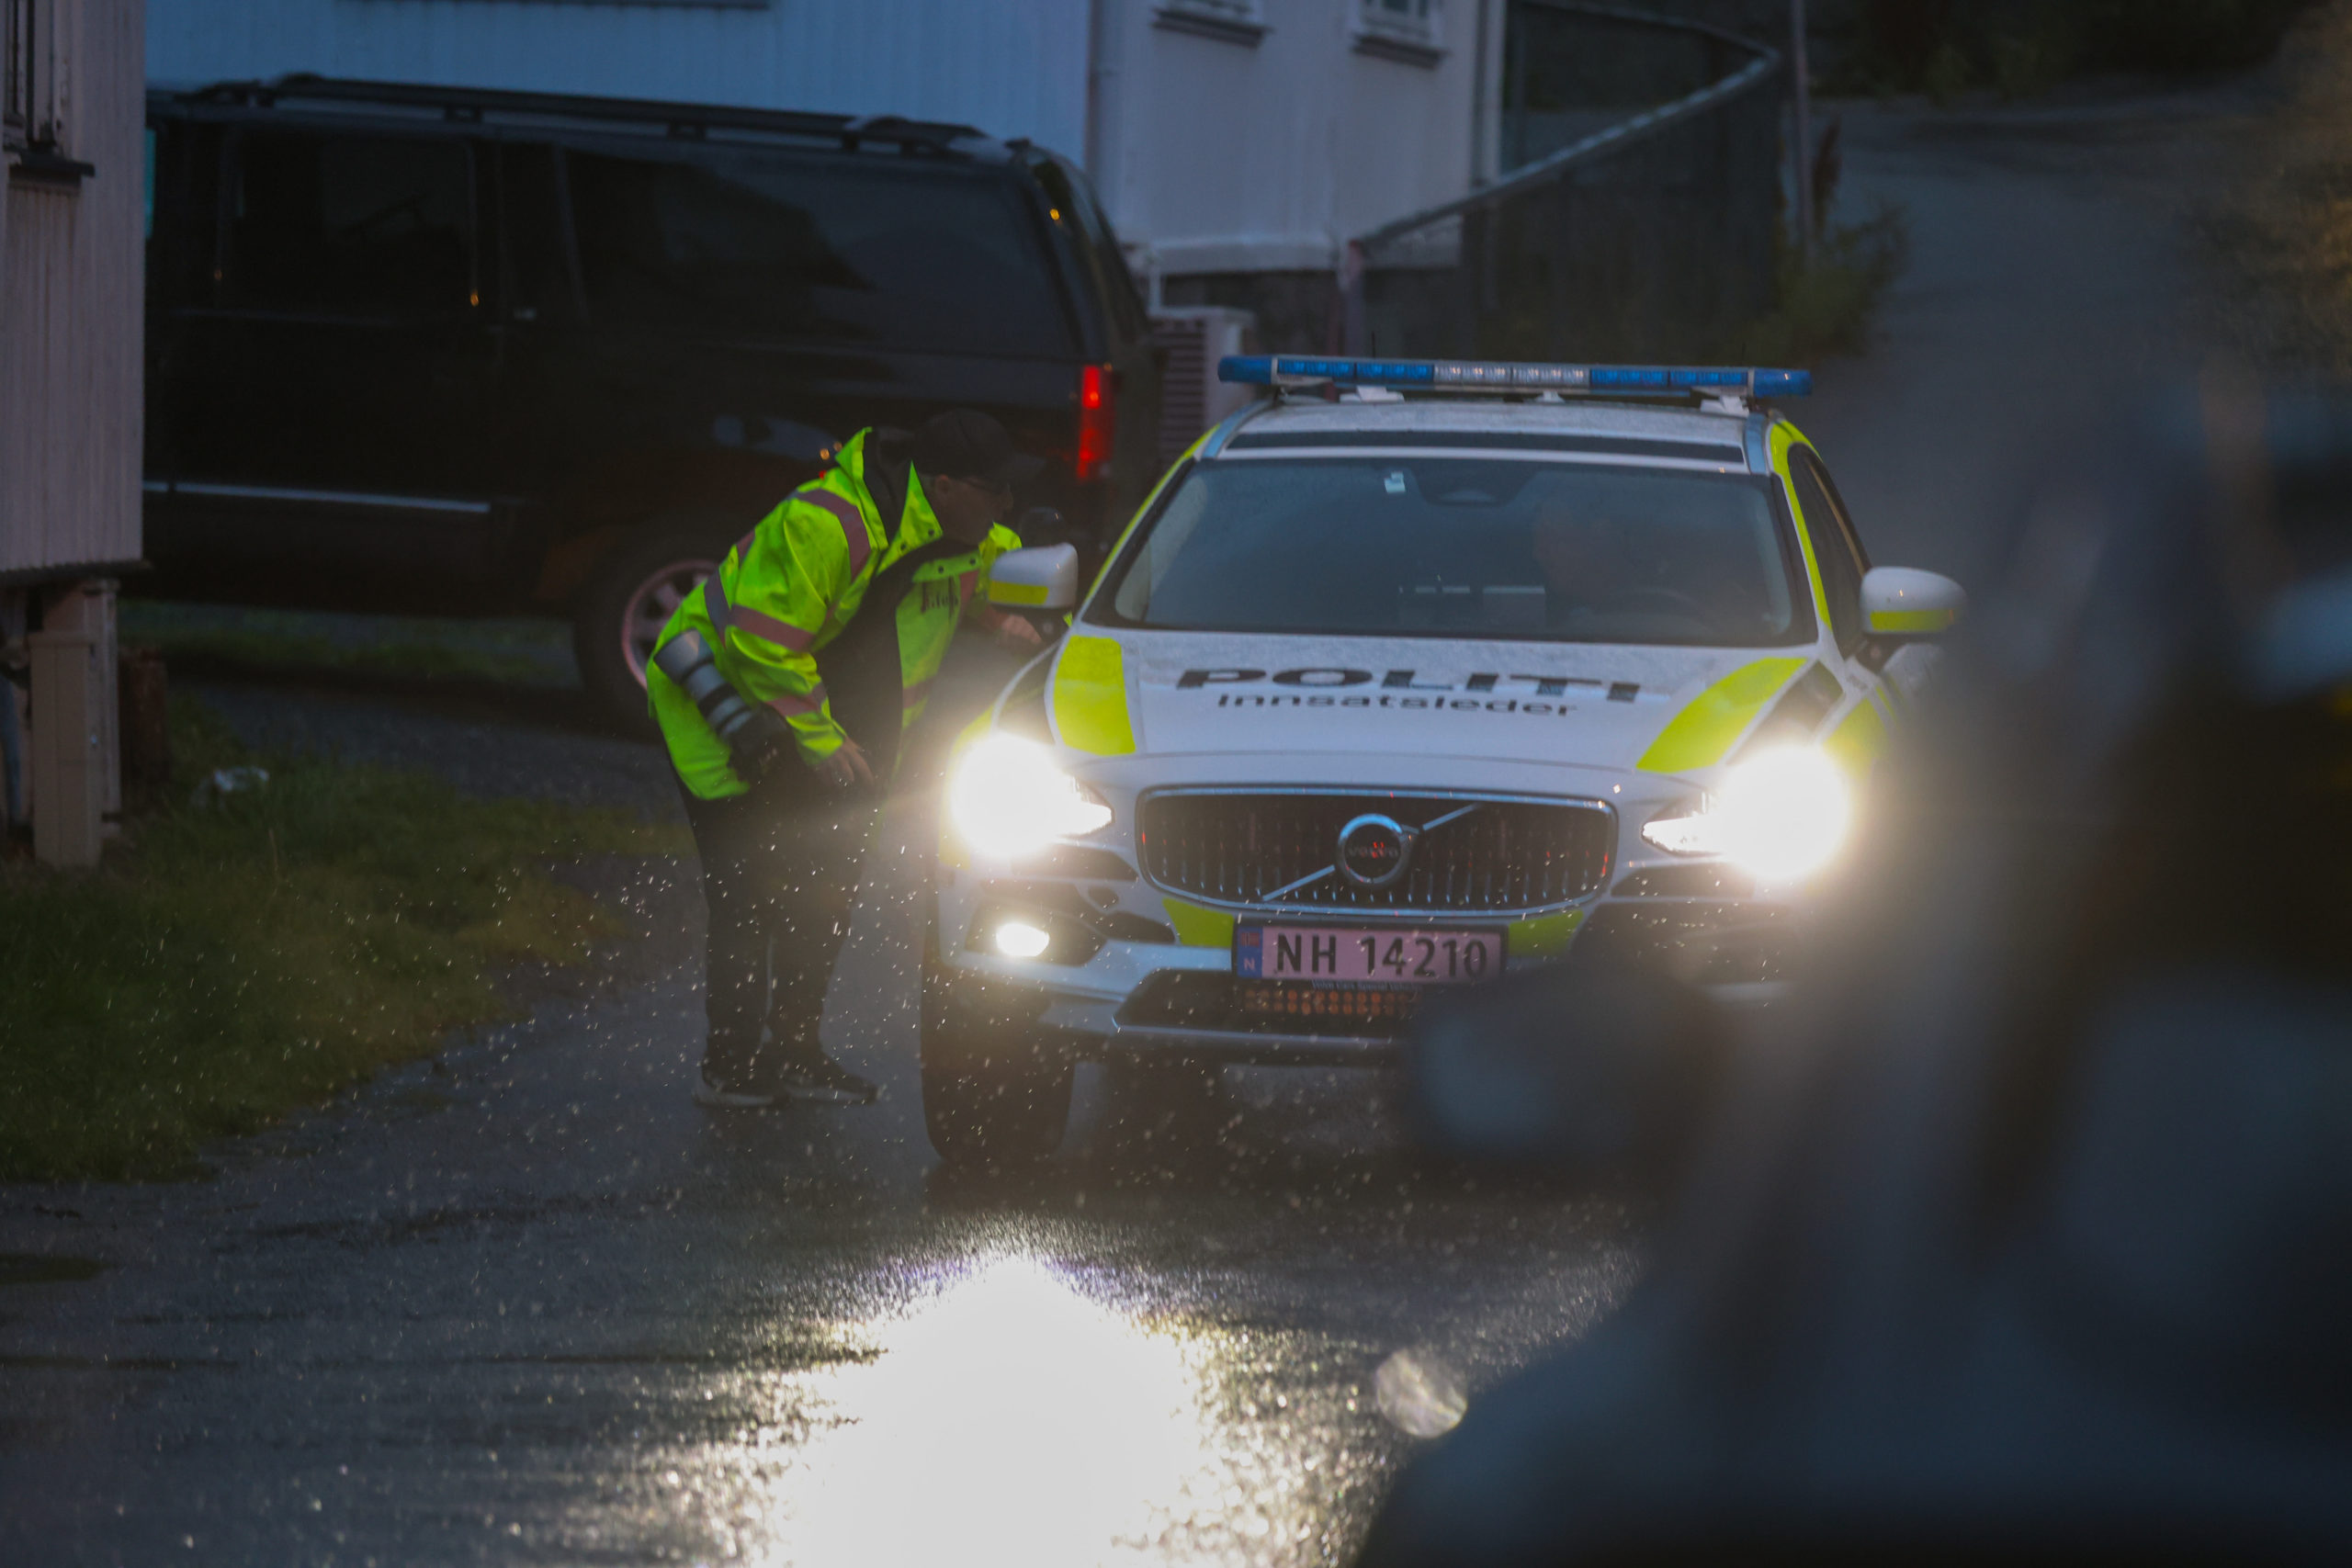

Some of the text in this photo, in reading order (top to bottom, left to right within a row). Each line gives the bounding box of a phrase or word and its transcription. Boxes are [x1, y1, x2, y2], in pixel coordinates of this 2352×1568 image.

[1177, 670, 1641, 702] POLITI
[1217, 694, 1578, 716] Innsatsleder
[1244, 958, 1256, 971] N
[1276, 933, 1487, 977] NH 14210
